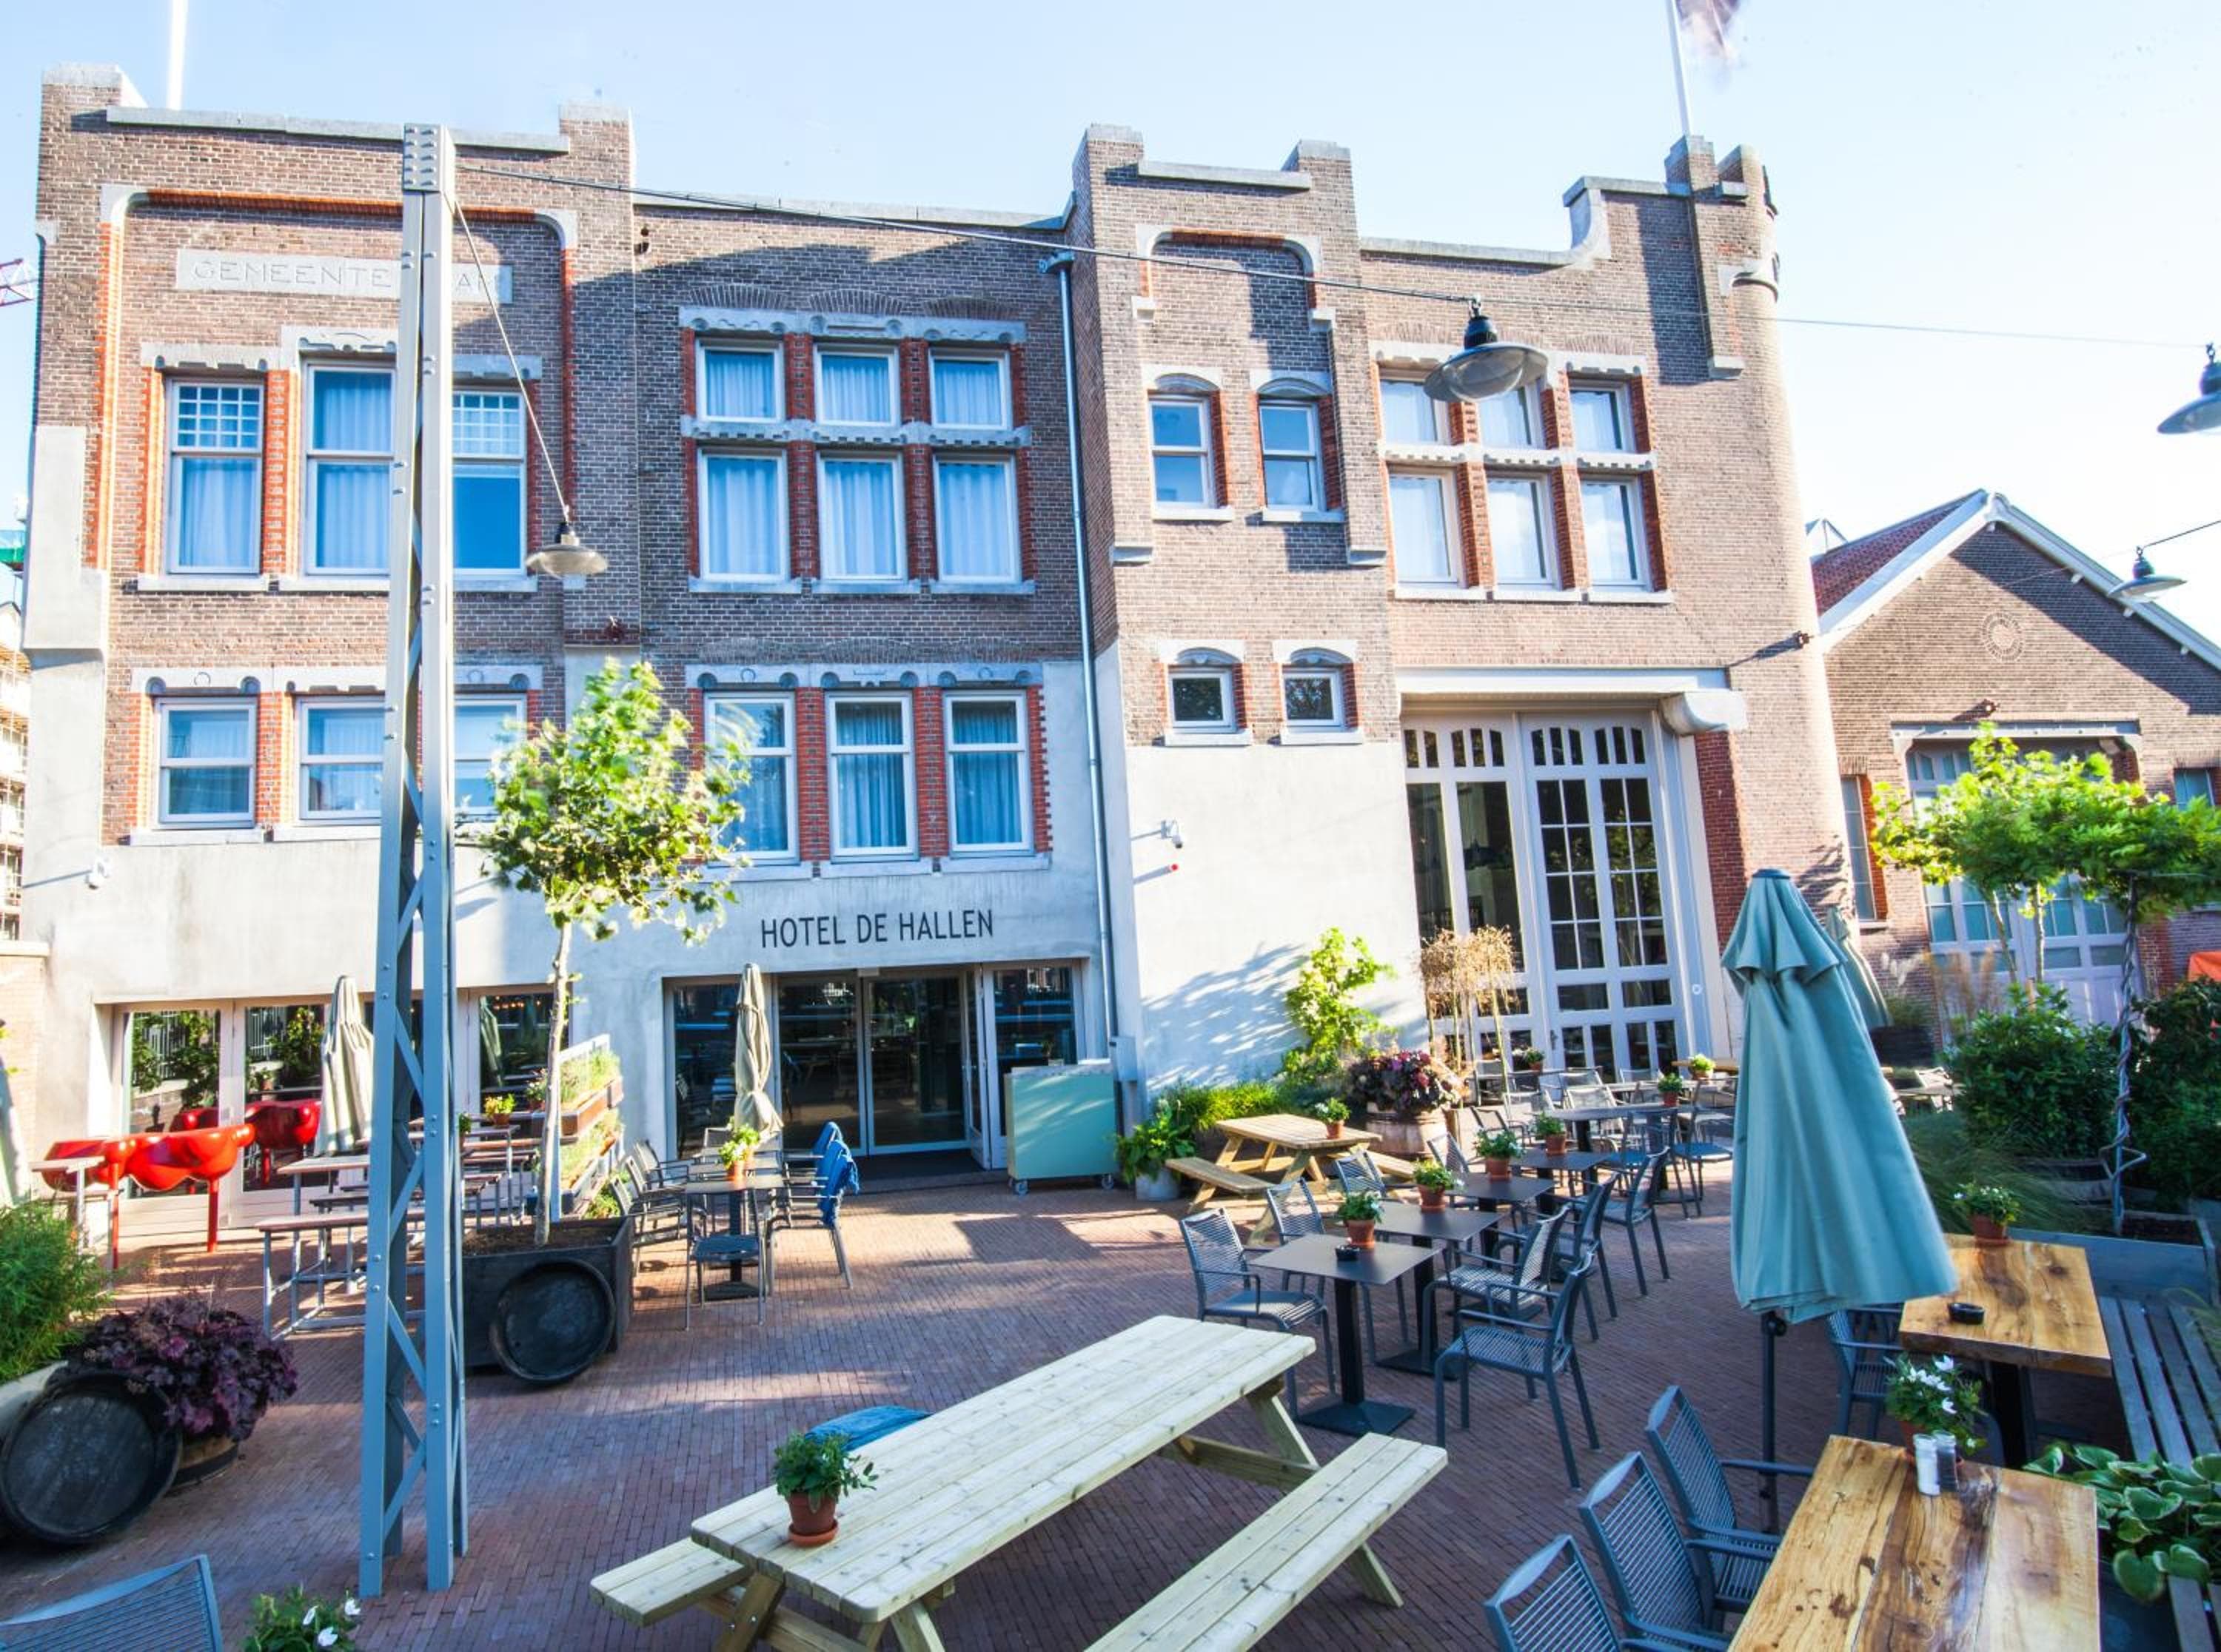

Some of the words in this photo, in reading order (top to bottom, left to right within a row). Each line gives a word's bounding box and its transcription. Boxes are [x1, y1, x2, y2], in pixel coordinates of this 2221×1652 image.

[194, 261, 392, 288] GEMEENTE
[761, 916, 846, 948] HOTEL
[857, 913, 888, 944] DE
[899, 909, 994, 941] HALLEN
